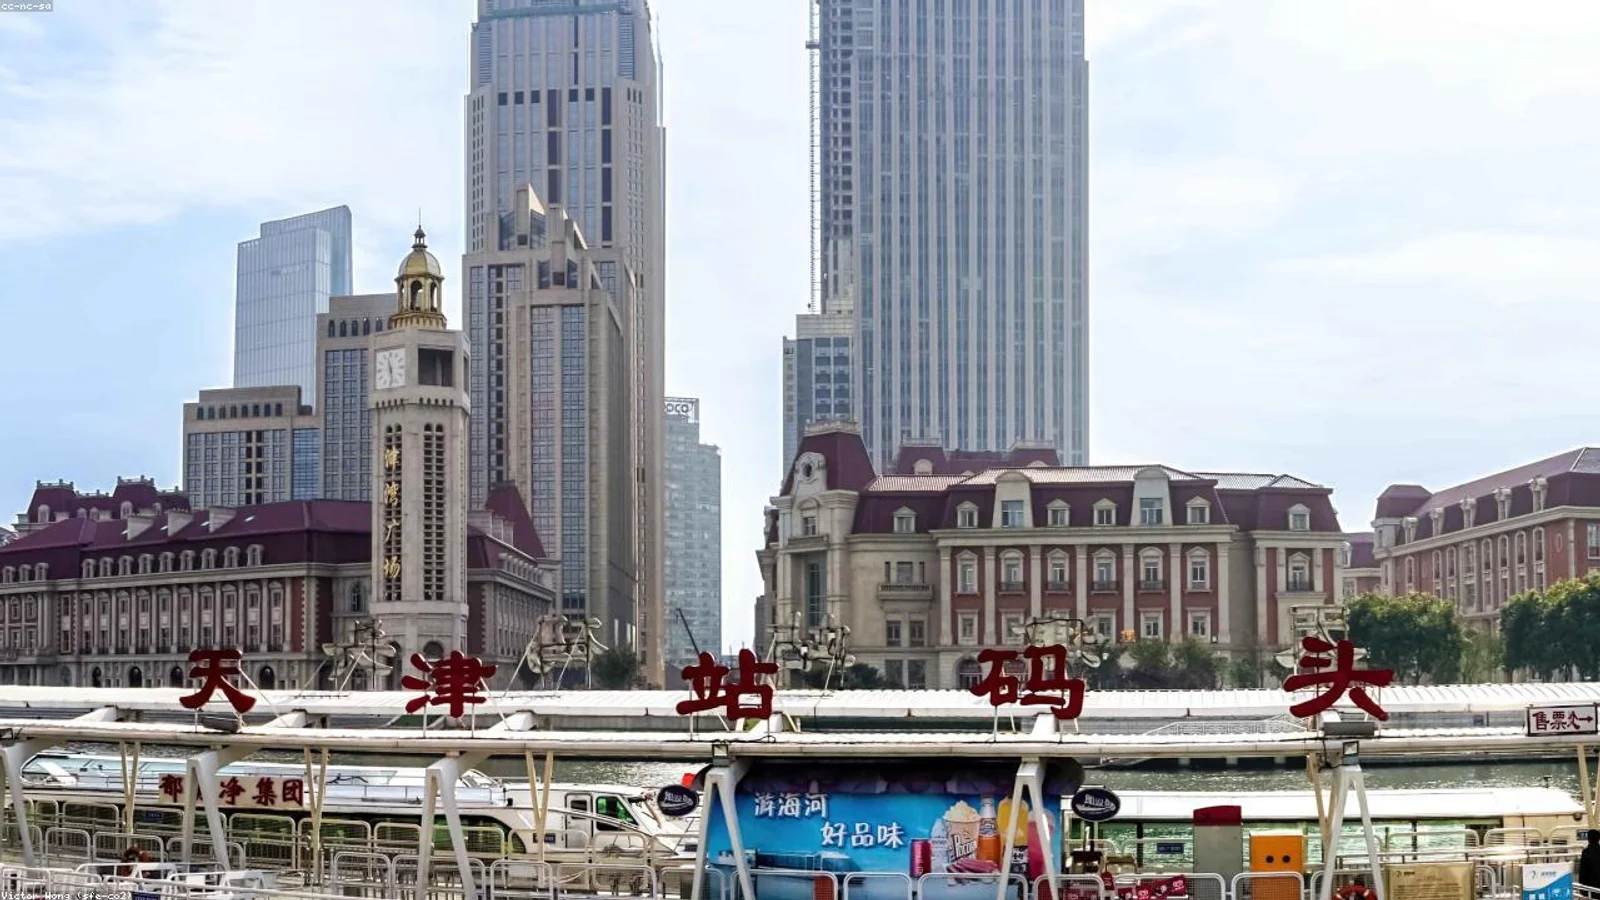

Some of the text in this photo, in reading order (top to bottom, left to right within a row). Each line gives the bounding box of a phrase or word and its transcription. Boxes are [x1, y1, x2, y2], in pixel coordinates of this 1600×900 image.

[179, 636, 1394, 721] 天津站码头
[159, 773, 304, 806] 郁净集团
[821, 821, 905, 848] 好品味
